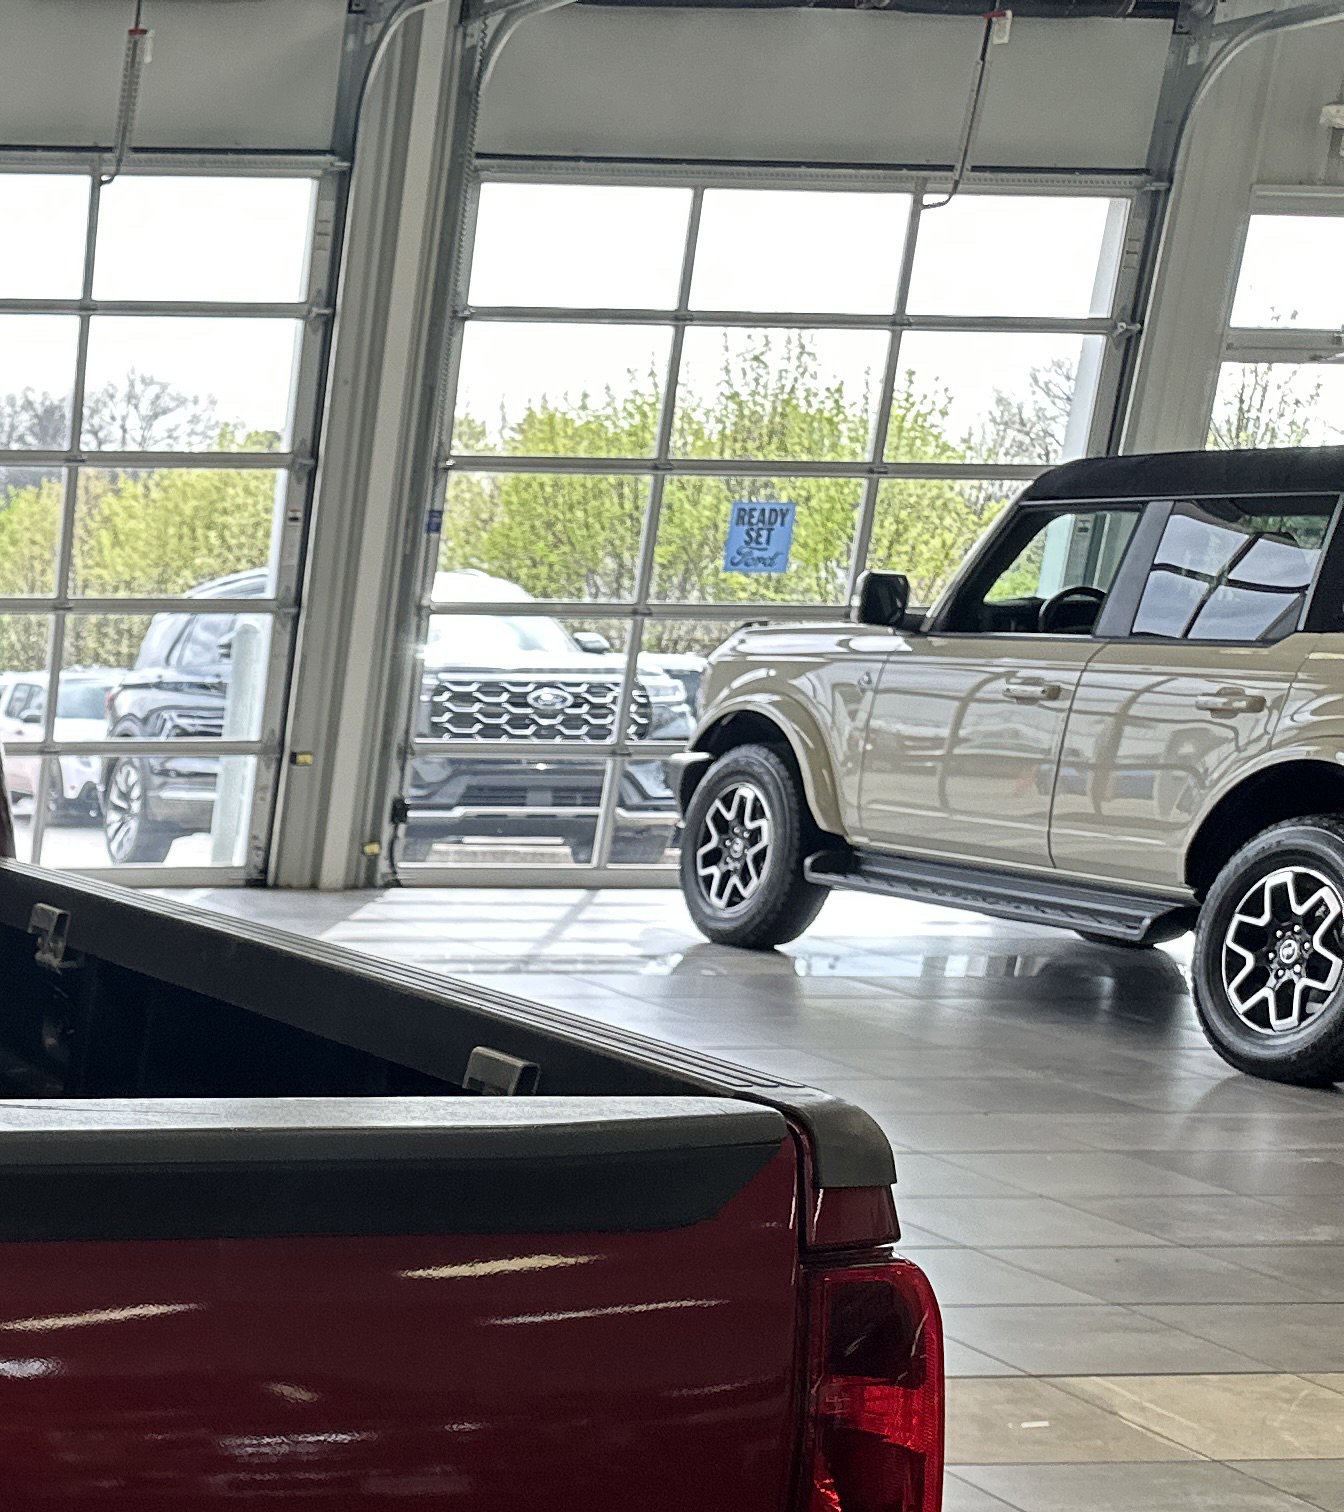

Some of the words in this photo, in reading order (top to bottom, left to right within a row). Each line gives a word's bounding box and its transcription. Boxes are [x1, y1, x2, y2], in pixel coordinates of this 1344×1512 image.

[735, 507, 790, 528] READY
[743, 527, 775, 546] SET
[729, 545, 785, 567] Ford
